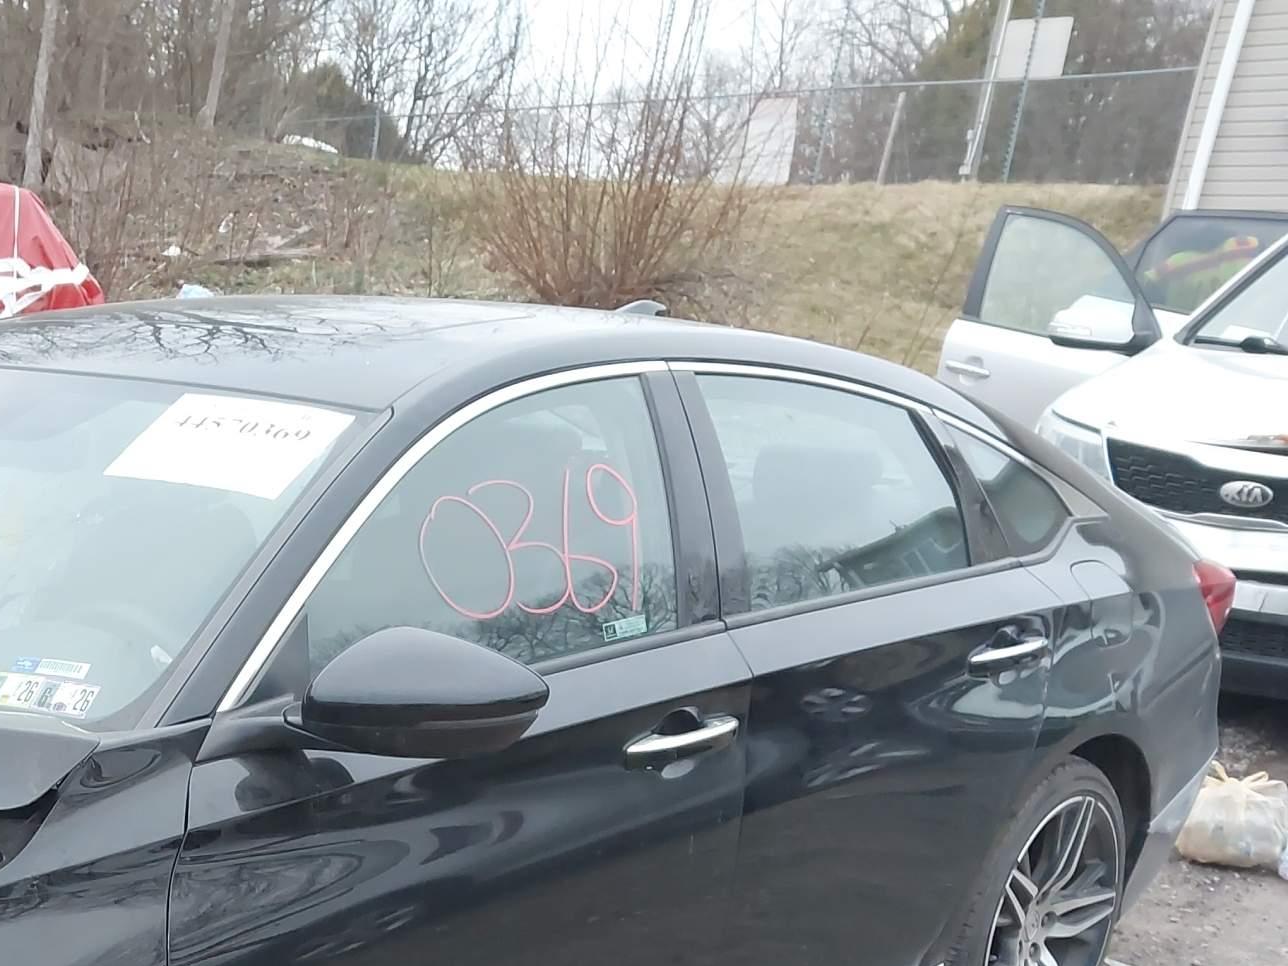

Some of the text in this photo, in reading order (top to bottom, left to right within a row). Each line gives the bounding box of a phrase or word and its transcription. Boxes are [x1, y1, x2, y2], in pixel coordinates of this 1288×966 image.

[1223, 483, 1267, 504] KIA
[418, 462, 638, 621] 0369
[16, 680, 39, 703] 26
[72, 688, 95, 712] 26
